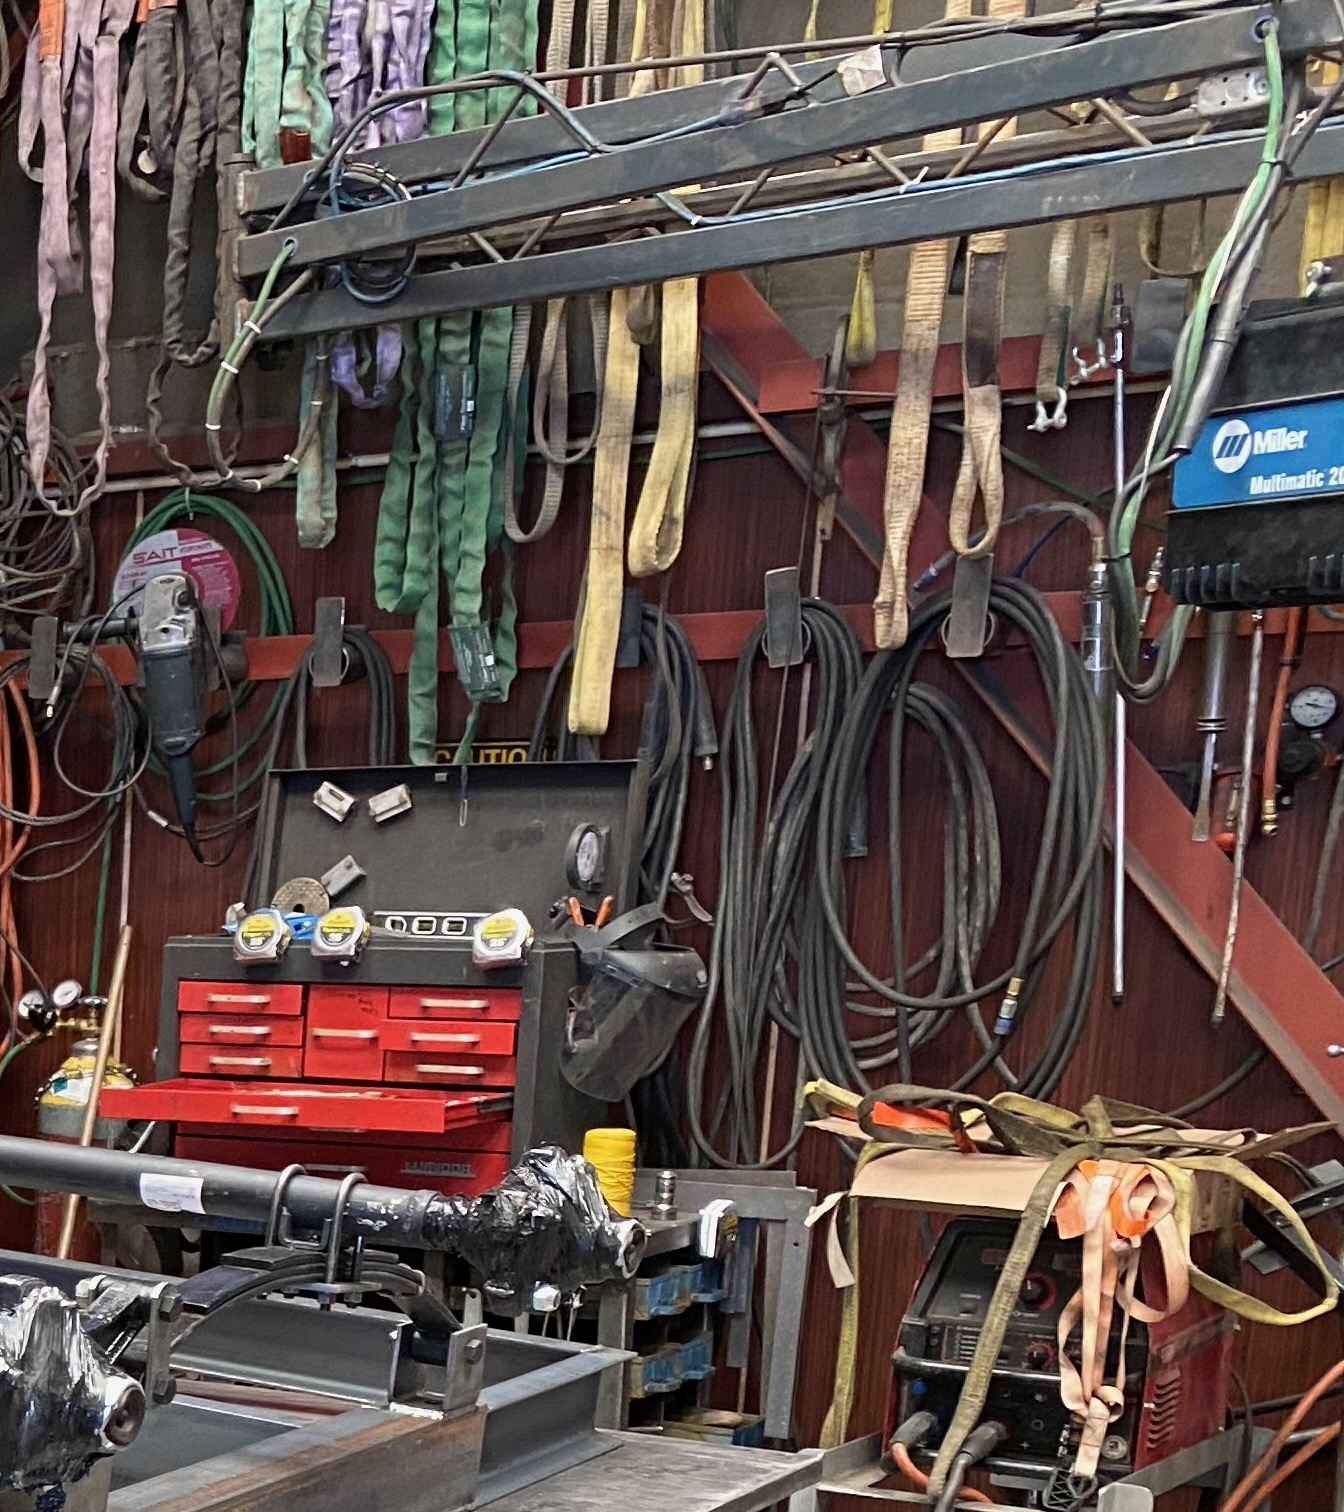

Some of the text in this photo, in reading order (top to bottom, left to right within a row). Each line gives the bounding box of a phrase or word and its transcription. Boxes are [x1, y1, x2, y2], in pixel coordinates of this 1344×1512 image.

[1253, 427, 1309, 455] Miller
[1250, 469, 1325, 495] Multimatic
[132, 546, 177, 565] SAIT
